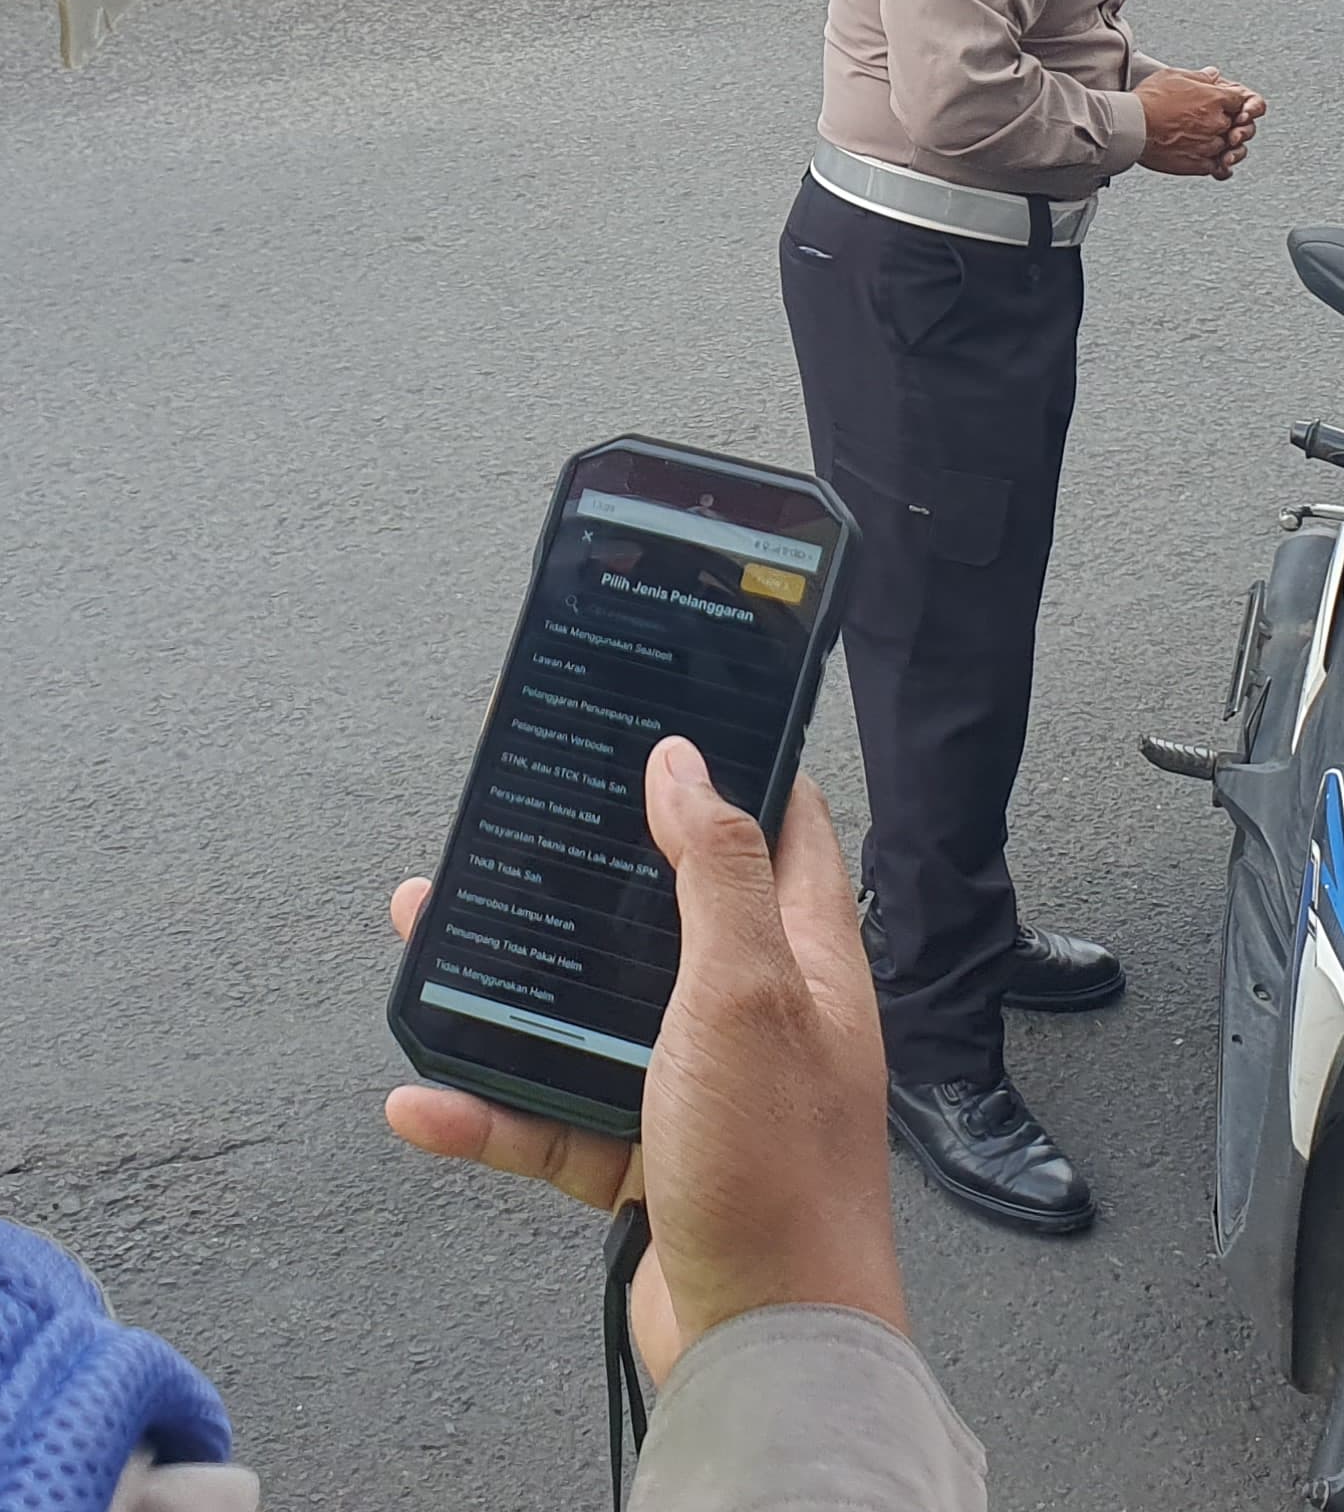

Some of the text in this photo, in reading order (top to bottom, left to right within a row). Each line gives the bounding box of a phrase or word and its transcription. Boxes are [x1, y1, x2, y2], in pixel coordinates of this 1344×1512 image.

[601, 572, 631, 591] Pilih
[632, 580, 669, 601] Jenis
[670, 589, 755, 623] Pelanggaran
[544, 619, 568, 634] Tidak
[569, 626, 633, 652] Menggunakan
[533, 653, 587, 674] Lawan Arah
[522, 685, 579, 709] Pelanggaran
[580, 701, 635, 725] Penumpang
[511, 718, 569, 743] Pelanggaran
[490, 786, 546, 810] Persyaratan
[548, 802, 577, 818] Teknis
[582, 774, 607, 790] Tidak
[608, 781, 627, 795] Sah
[479, 819, 535, 844] Persyaratan
[537, 835, 566, 853] Teknis
[567, 845, 587, 858] dan
[587, 849, 607, 865] Laik
[608, 856, 634, 872] Jalan
[497, 862, 523, 878] Tidak
[523, 871, 543, 884] Sah
[456, 888, 575, 932] Menerobos Lampu Merah
[446, 923, 583, 972] Penumpang Tidak Pakai Helm
[435, 958, 555, 1003] Tidak Menggunakan Helm
